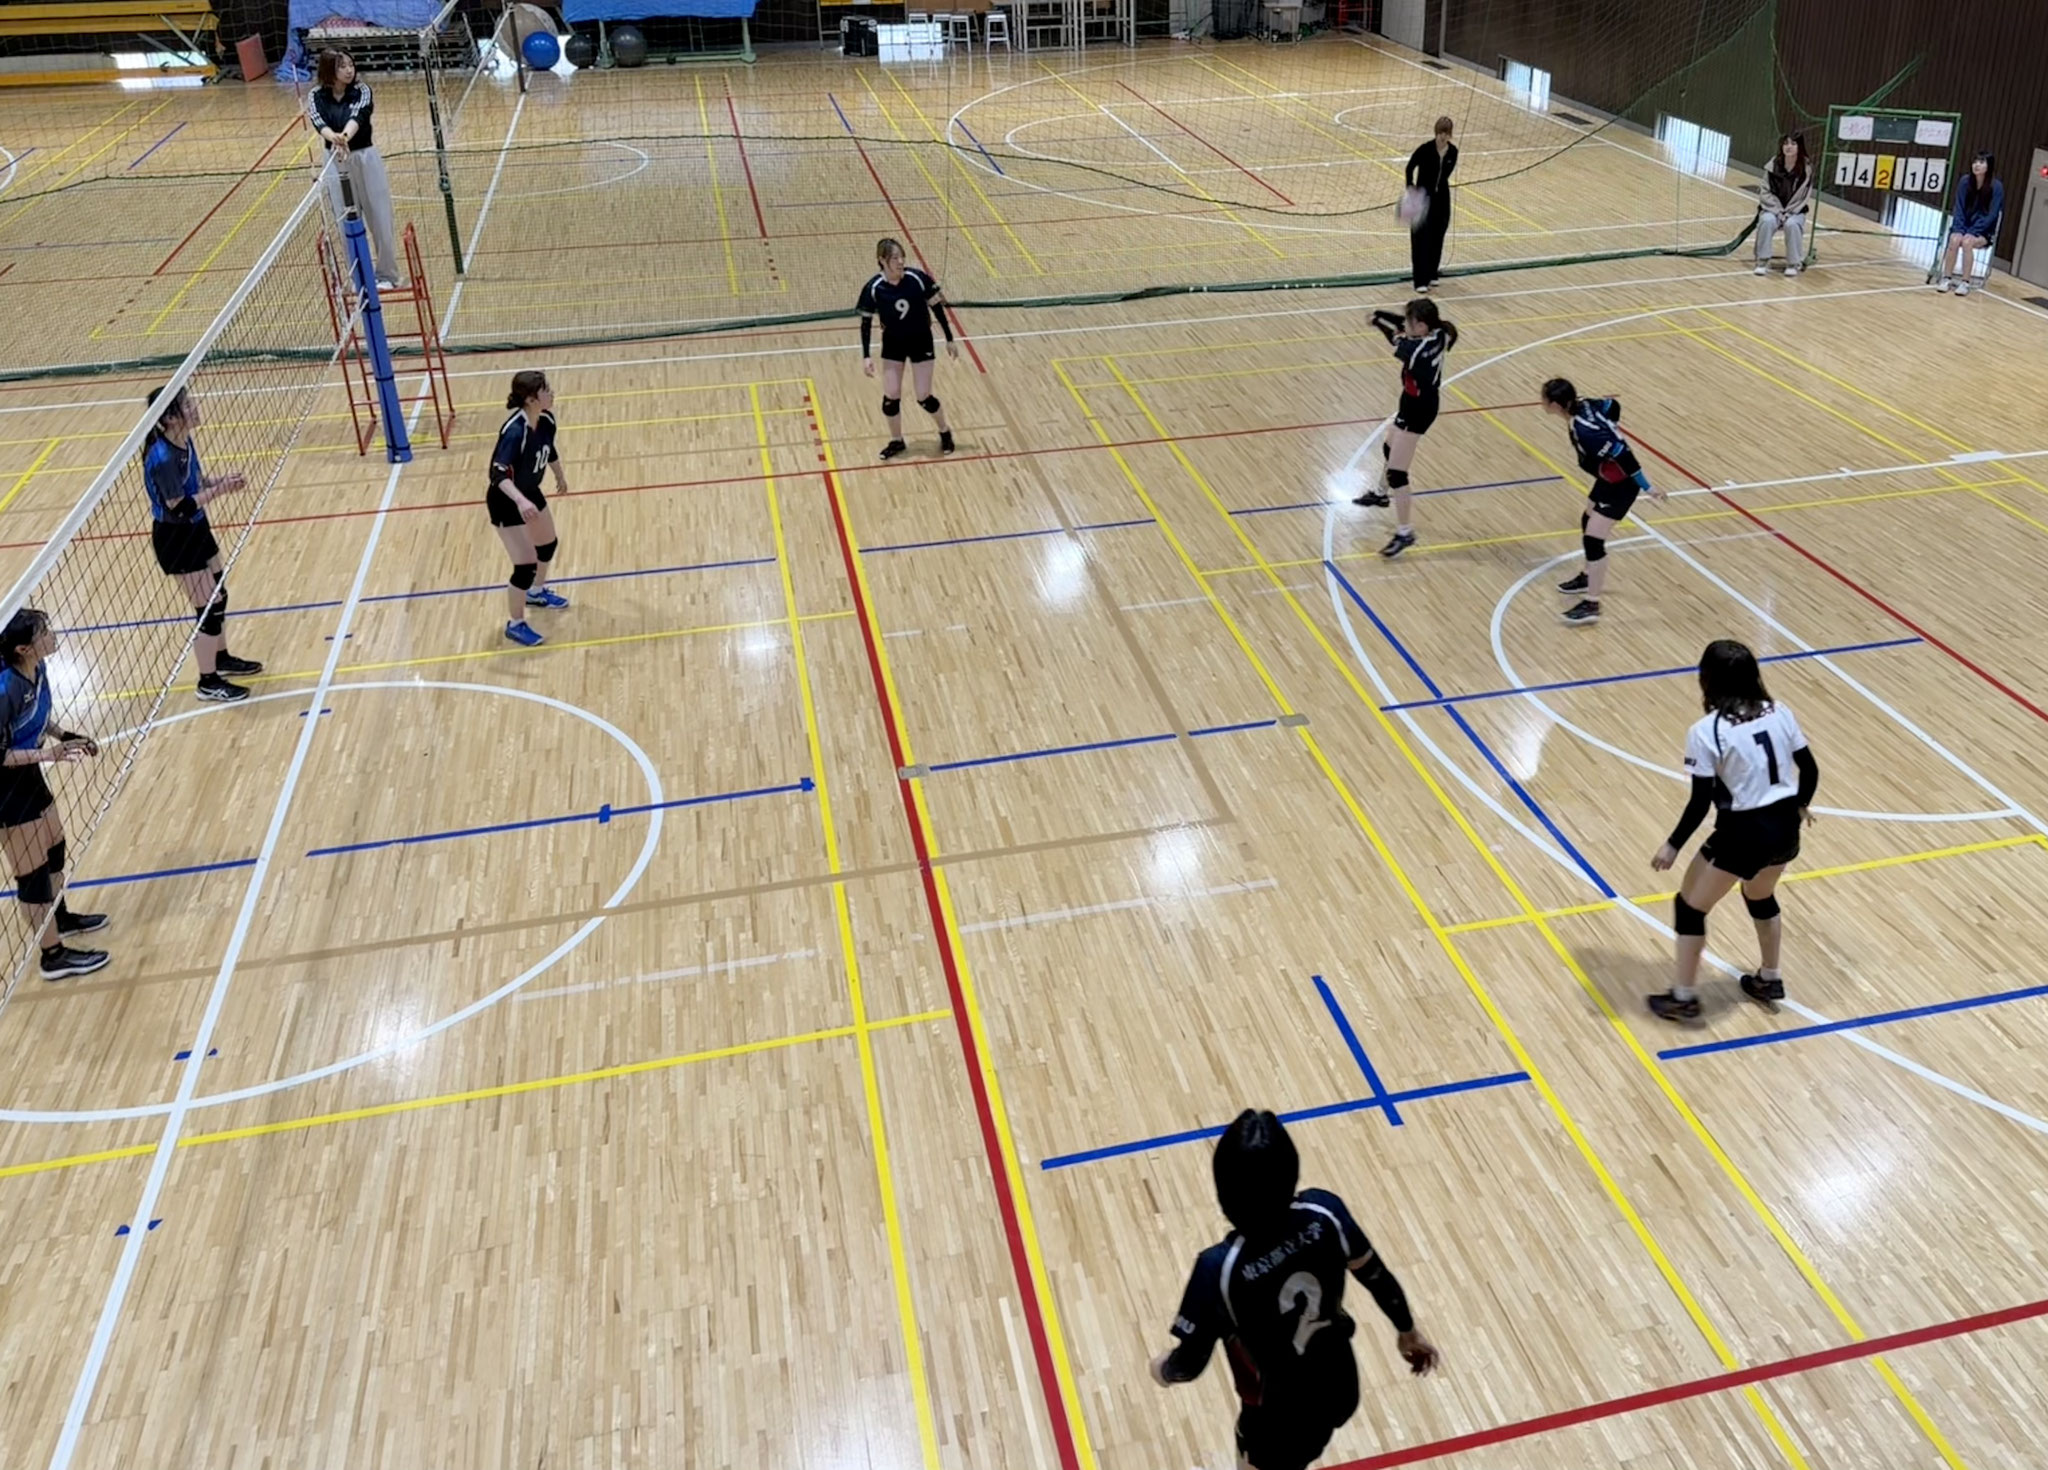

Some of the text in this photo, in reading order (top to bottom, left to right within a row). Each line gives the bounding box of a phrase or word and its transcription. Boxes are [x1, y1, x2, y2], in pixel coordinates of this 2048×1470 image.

[1877, 169, 1890, 186] 2
[894, 298, 910, 321] 9
[532, 444, 551, 474] 10
[1752, 730, 1780, 786] 1
[1278, 1270, 1333, 1356] 2
